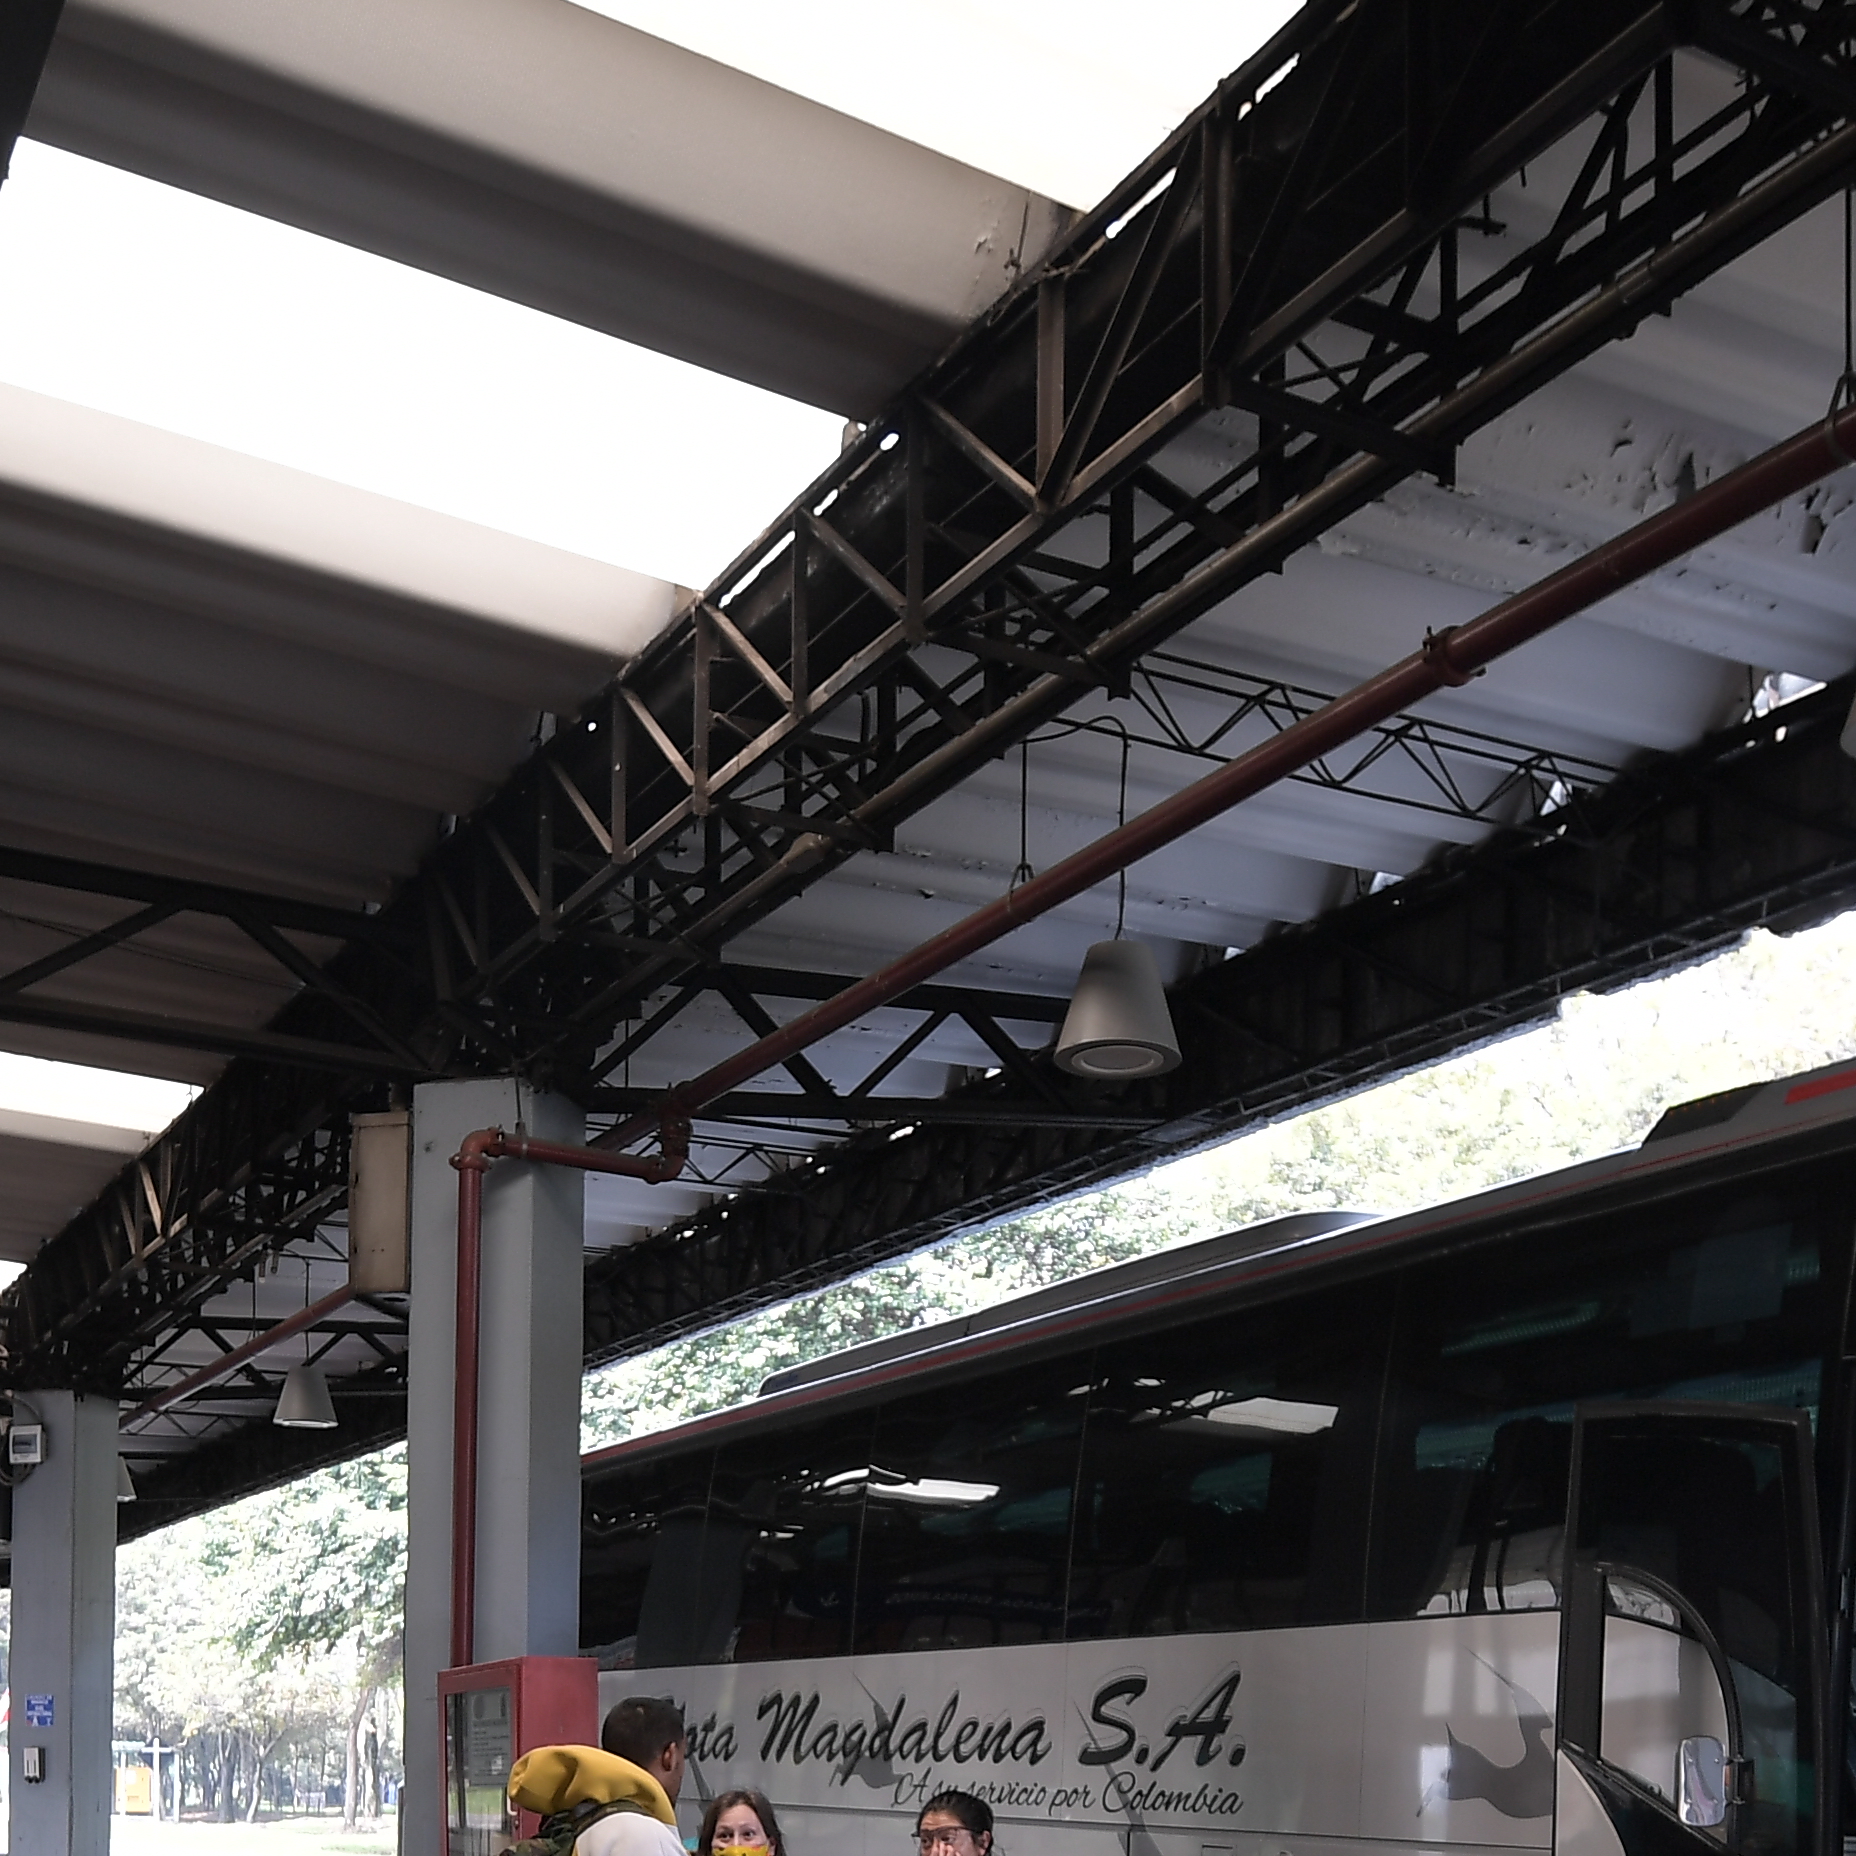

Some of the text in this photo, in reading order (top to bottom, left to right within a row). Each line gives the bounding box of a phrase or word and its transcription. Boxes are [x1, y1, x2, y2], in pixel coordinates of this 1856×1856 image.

[672, 1662, 1248, 1784] ota Magdalena S.A.
[891, 1766, 932, 1808] A
[966, 1780, 1047, 1808] servicio
[1048, 1784, 1097, 1817] por
[1101, 1769, 1245, 1818] Colombia
